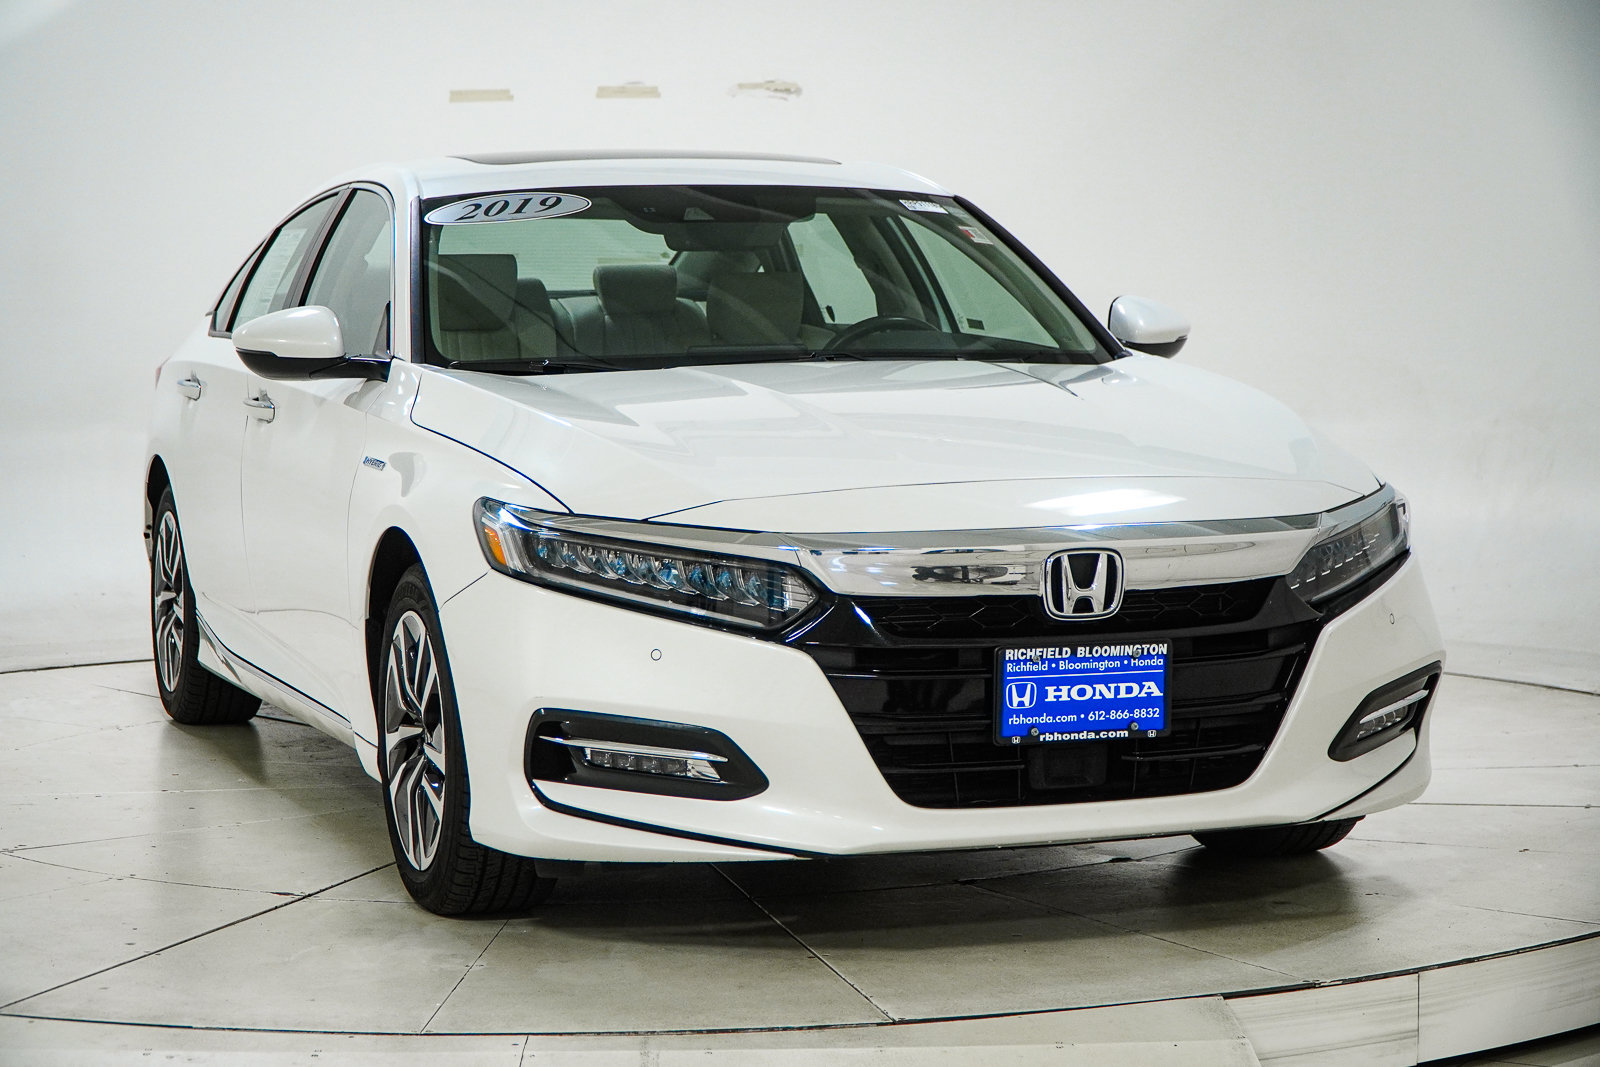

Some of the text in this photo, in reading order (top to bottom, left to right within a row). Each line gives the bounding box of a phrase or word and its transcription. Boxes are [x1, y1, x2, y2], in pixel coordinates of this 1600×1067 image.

[455, 196, 562, 221] 2019
[1005, 644, 1168, 660] RICHFIELD BLOOMINGTON
[1006, 656, 1163, 672] Richfield Bloomington Honda
[1044, 681, 1163, 702] HONDA
[1008, 707, 1160, 725] rbhonda.com 612-866-8832
[1039, 730, 1129, 742] rbhonda.com
